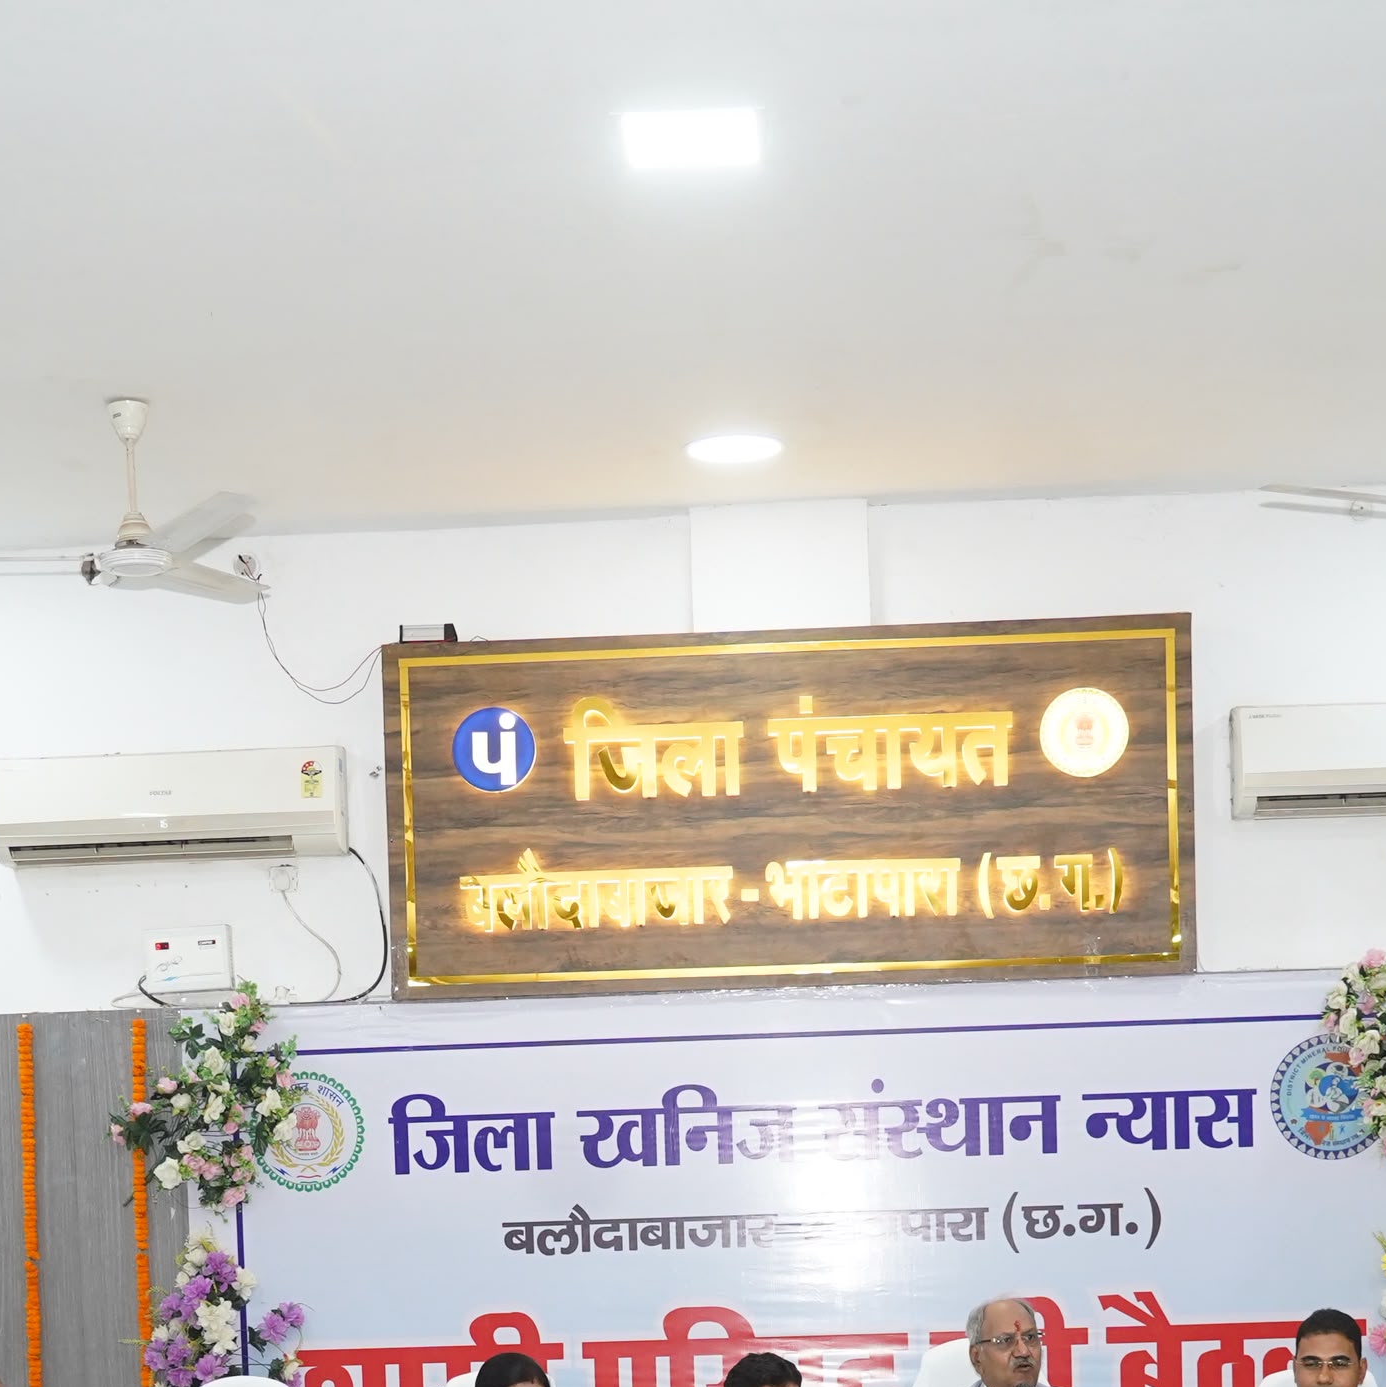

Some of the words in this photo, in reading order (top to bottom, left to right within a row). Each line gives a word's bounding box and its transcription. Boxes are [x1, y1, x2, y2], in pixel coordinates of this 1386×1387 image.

[563, 696, 744, 801] जिला
[767, 695, 1013, 793] पंचायत
[977, 846, 1124, 920] (छ.ग.)
[388, 1093, 555, 1175] जिला
[576, 1084, 797, 1169] खनिज
[817, 1077, 1061, 1161] संस्थान
[1081, 1087, 1257, 1151] न्यास
[1001, 1187, 1162, 1254] (छ.ग.)
